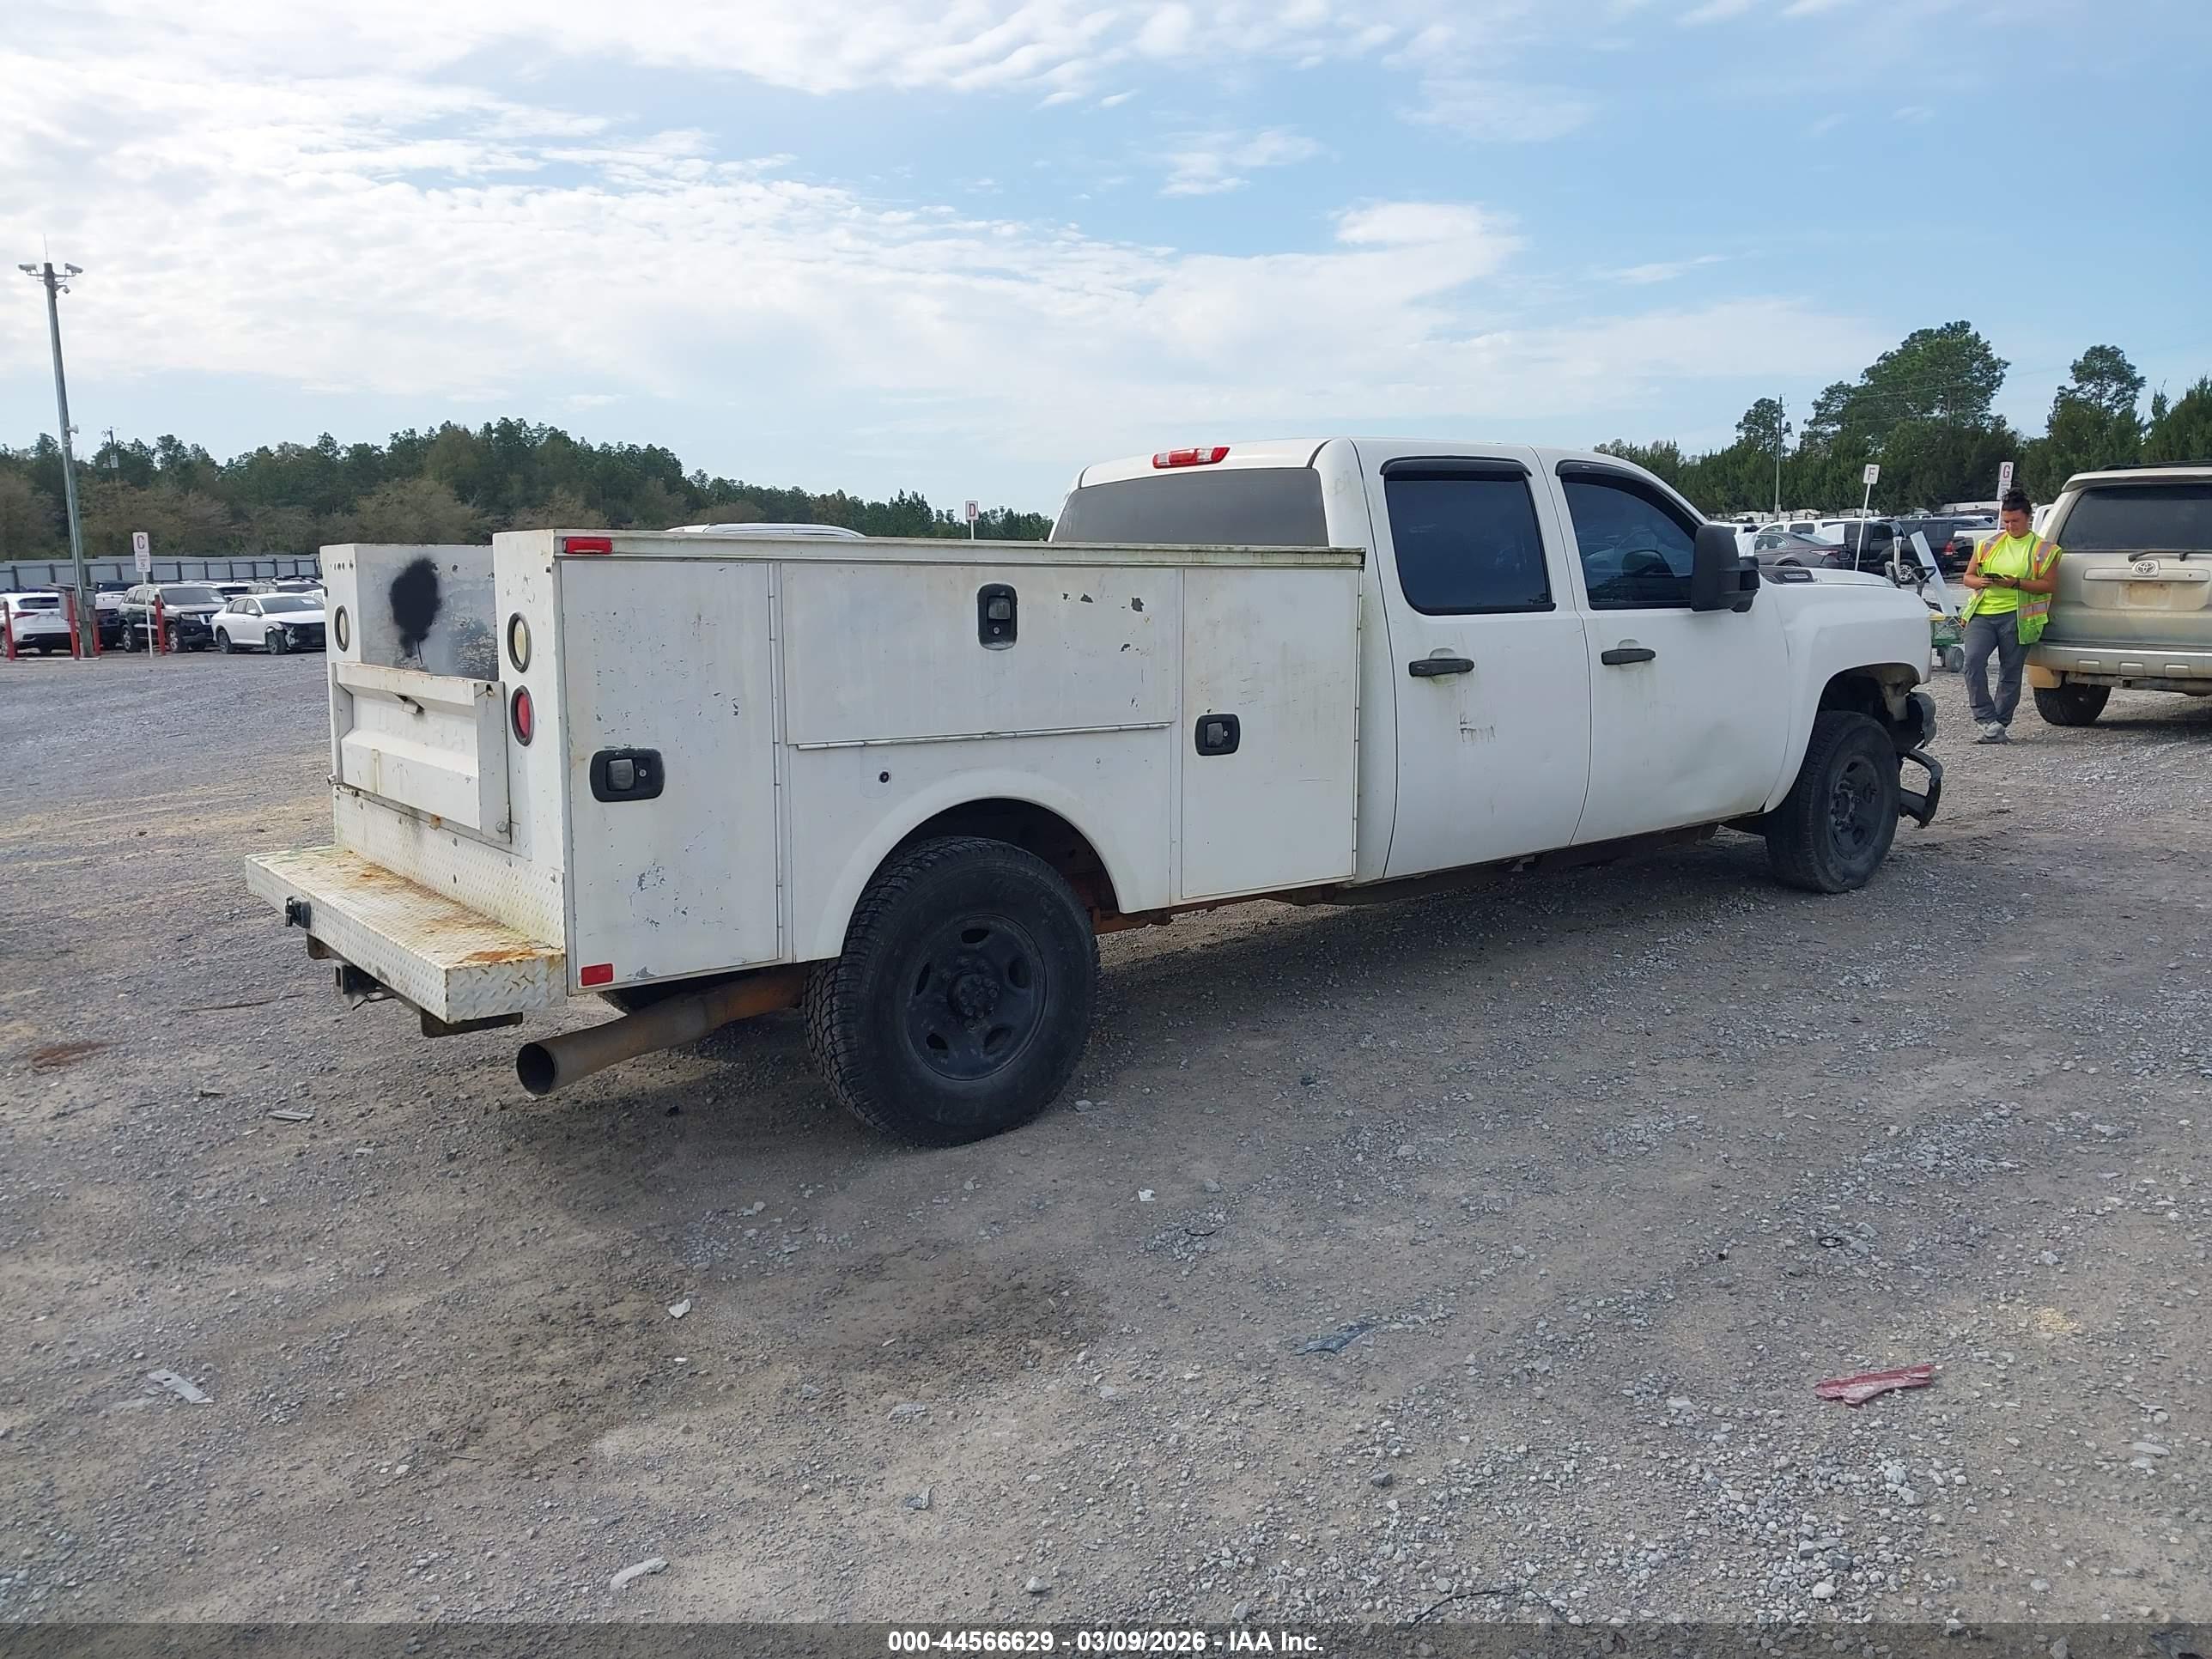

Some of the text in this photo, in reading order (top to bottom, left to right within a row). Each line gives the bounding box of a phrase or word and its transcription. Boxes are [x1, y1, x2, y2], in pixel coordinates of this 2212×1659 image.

[1867, 467, 1876, 481] F
[2002, 465, 2011, 479] G
[969, 503, 976, 517] D
[137, 535, 145, 550] C
